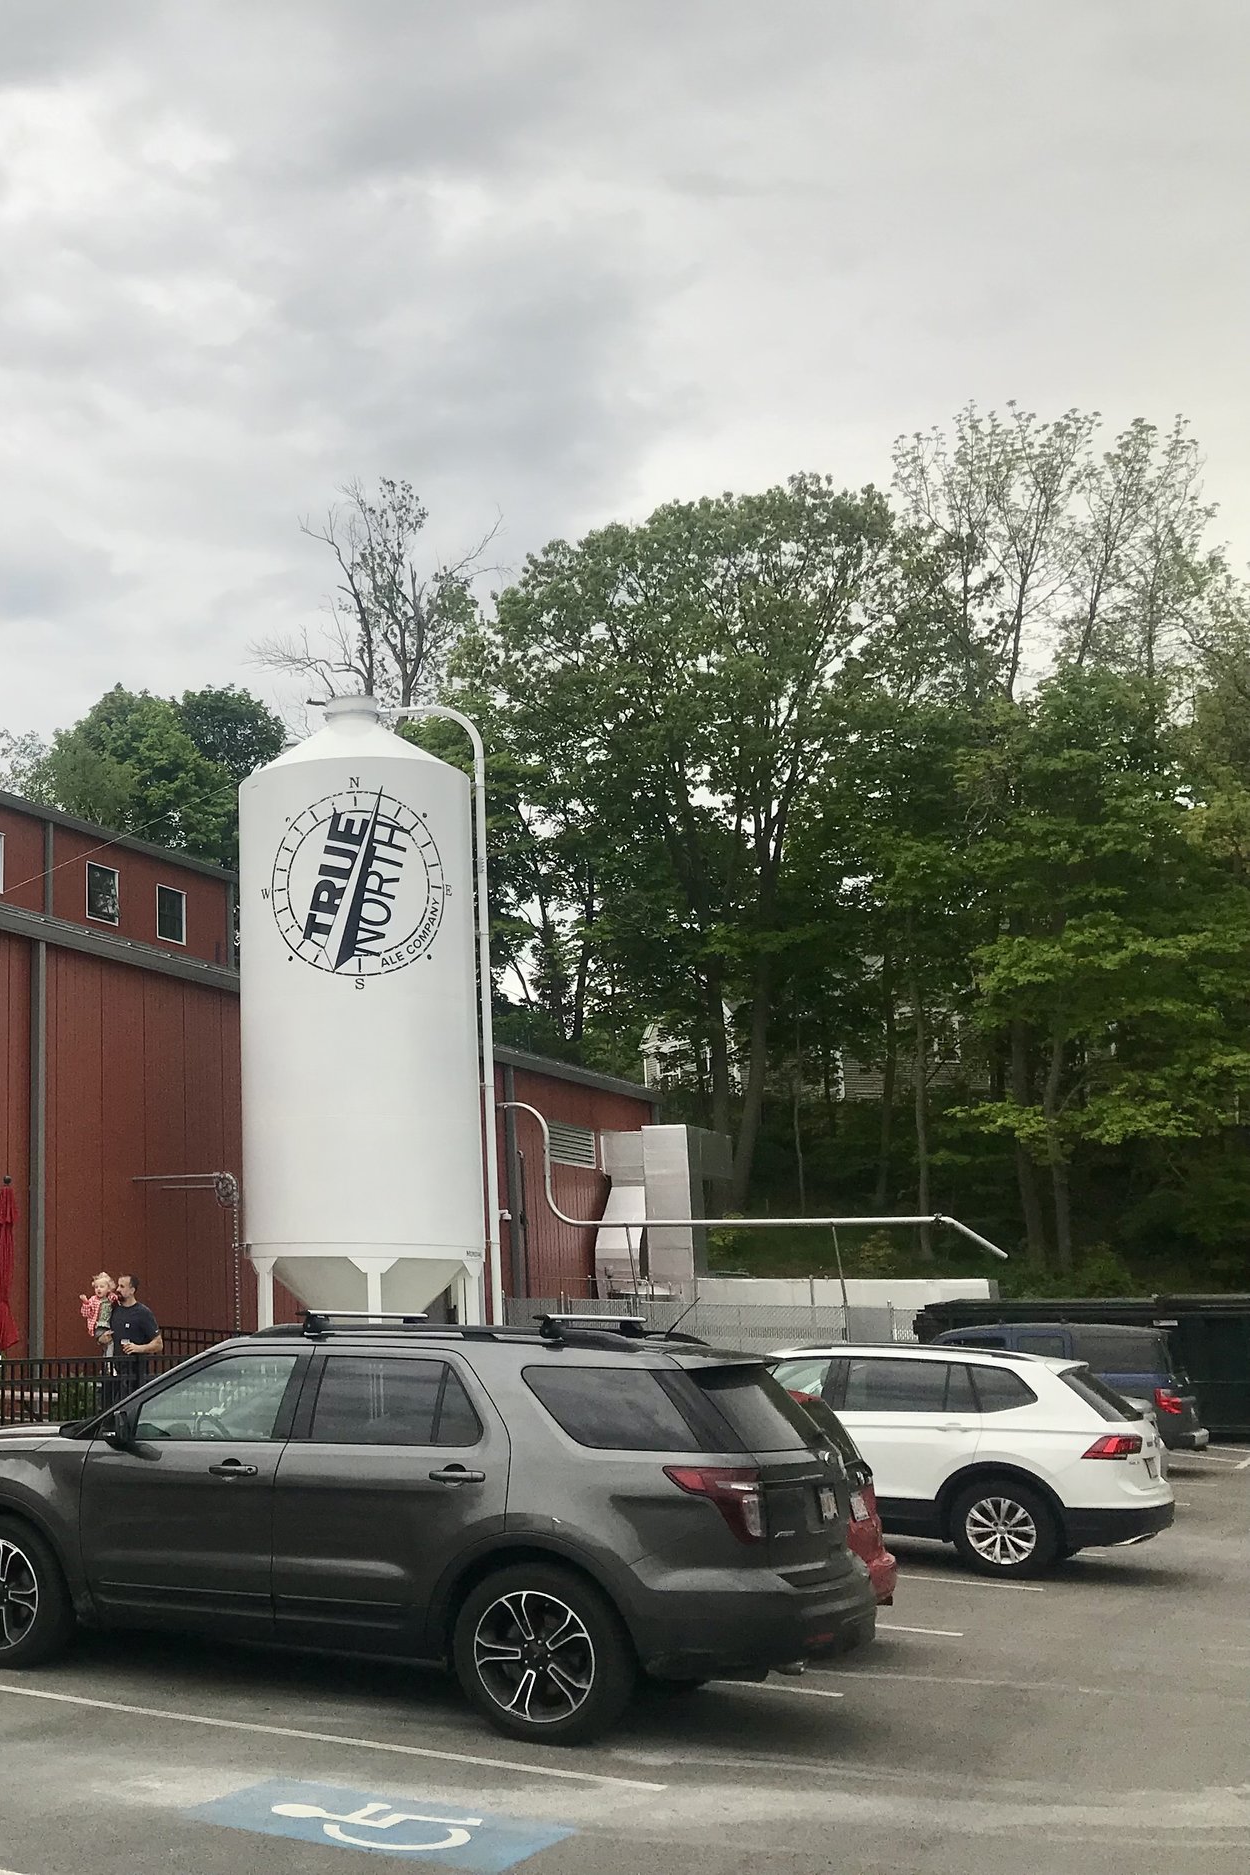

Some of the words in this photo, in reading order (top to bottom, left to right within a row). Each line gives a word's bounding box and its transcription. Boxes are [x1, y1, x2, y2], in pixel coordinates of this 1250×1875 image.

[349, 777, 360, 788] N
[302, 811, 371, 941] TRUE
[352, 816, 411, 957] NORTH
[445, 885, 453, 897] E
[261, 888, 272, 900] W
[380, 953, 405, 968] ALE
[407, 898, 440, 955] COMPANY
[355, 978, 365, 990] S
